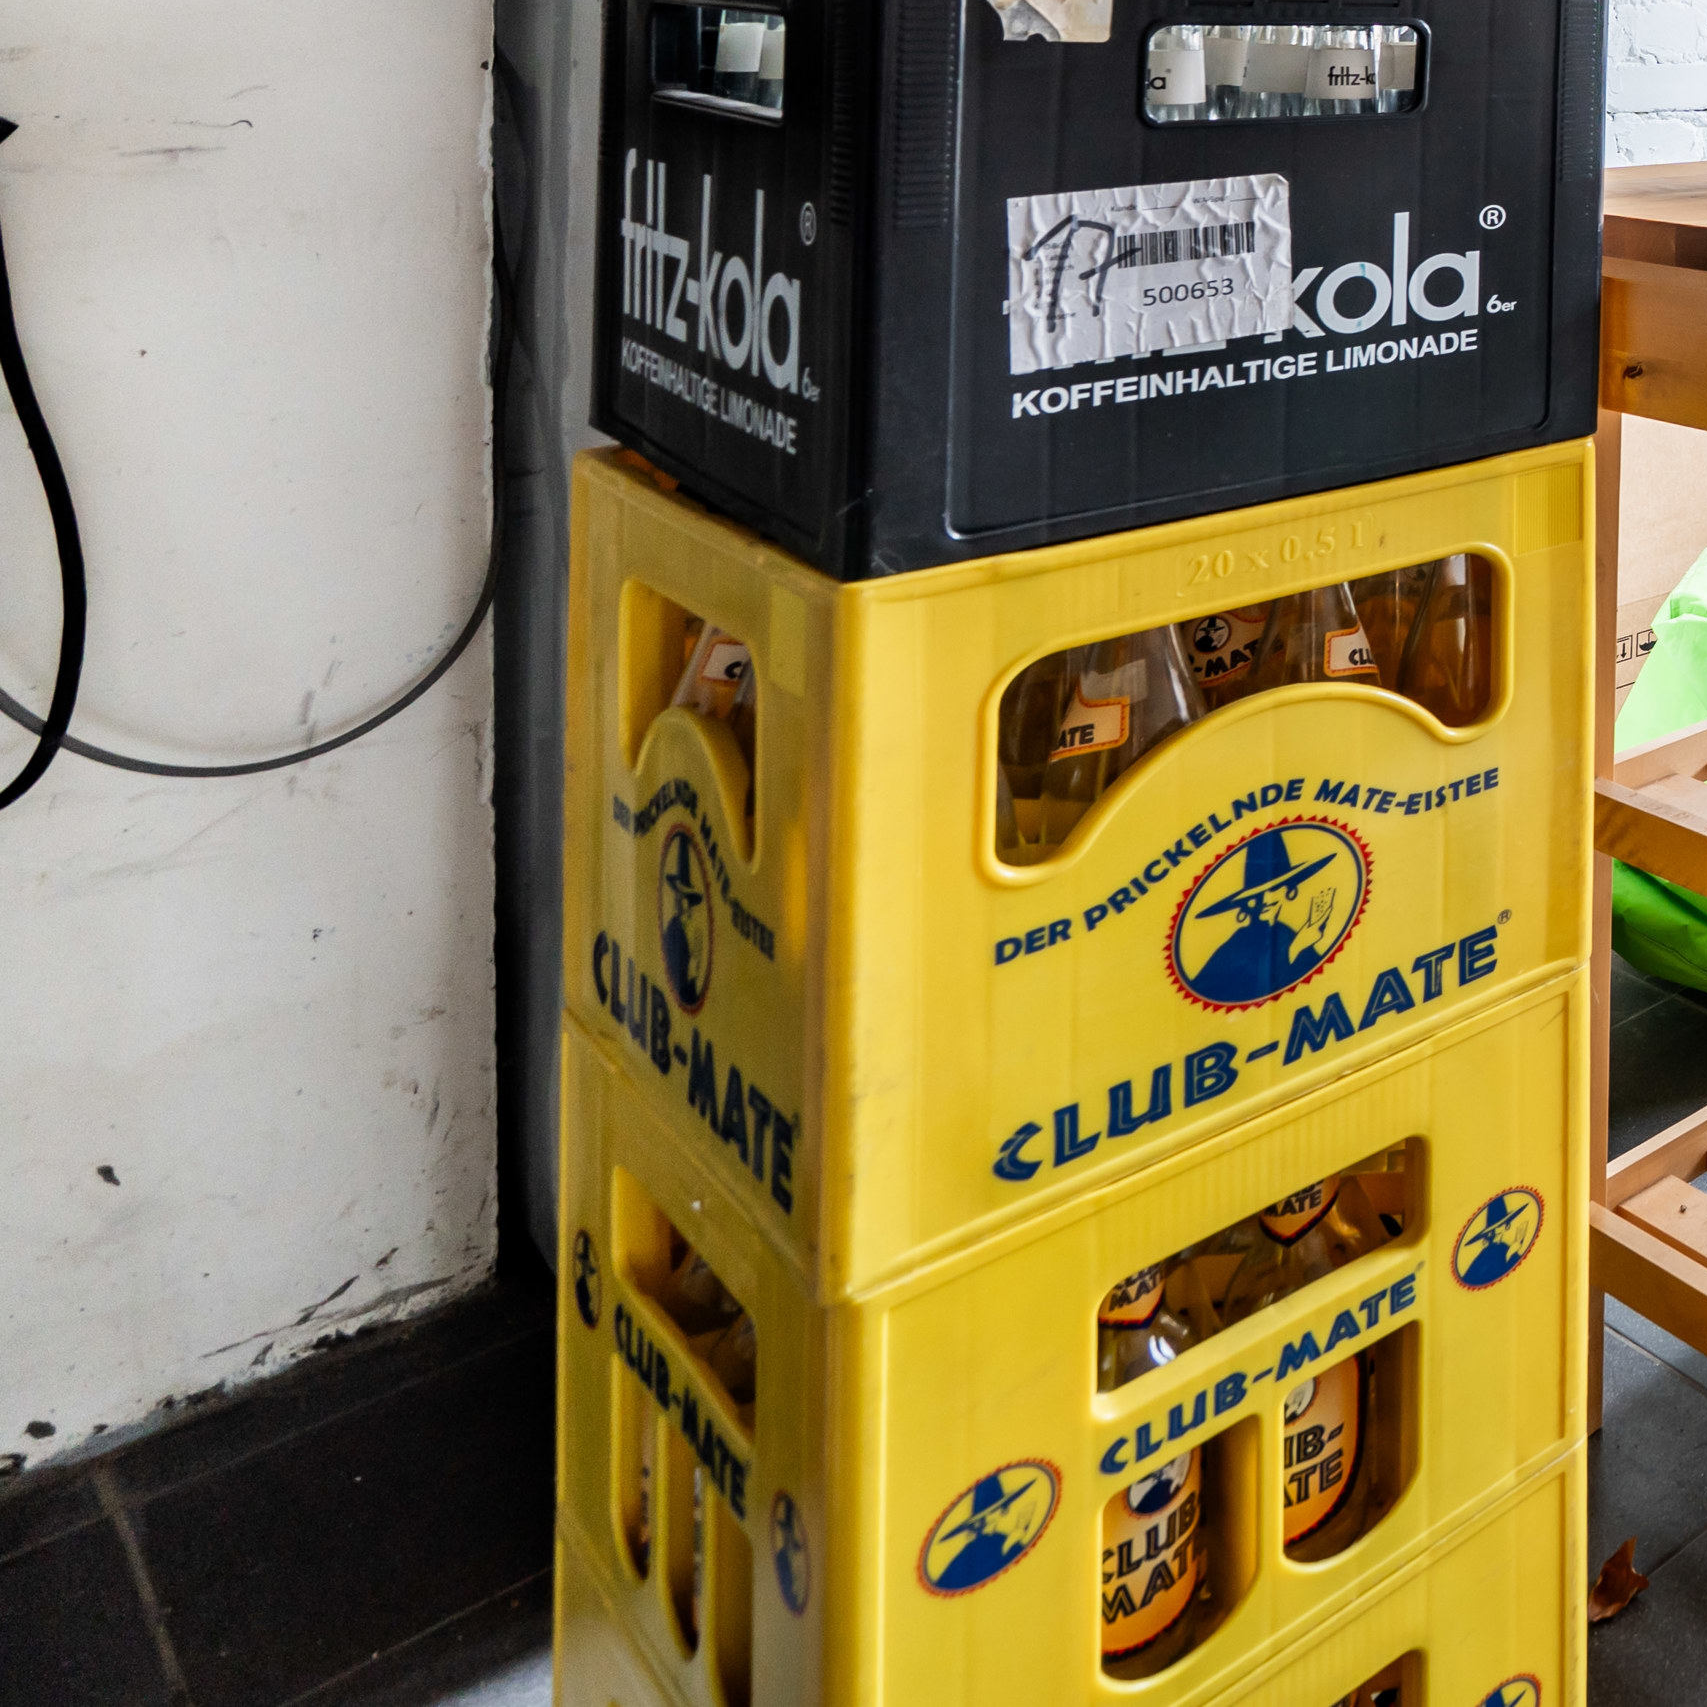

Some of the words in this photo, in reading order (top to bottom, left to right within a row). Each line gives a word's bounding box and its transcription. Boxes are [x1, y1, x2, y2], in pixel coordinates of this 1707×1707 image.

[620, 146, 802, 396] fritz-kola
[1141, 277, 1235, 308] 500653
[1485, 295, 1518, 315] 6er
[620, 336, 718, 420] KOFFEINHALTIGE
[719, 384, 798, 456] LIMONADE
[1011, 350, 1318, 420] KOFFEINHALTIGE
[1325, 328, 1479, 374] LIMONADE
[1186, 550, 1237, 586] 20
[1244, 546, 1272, 572] x
[1279, 520, 1336, 565] 0,5
[992, 916, 1074, 967] DER
[1082, 776, 1306, 932] PRICKELNDE
[1312, 766, 1500, 818] MATE-EISTEE
[591, 929, 796, 1217] CLUB-MATE
[991, 922, 1500, 1183] CLUB-MATE
[613, 1302, 748, 1522] CLUB-MATE
[1098, 1271, 1419, 1477] CLUB-MATE
